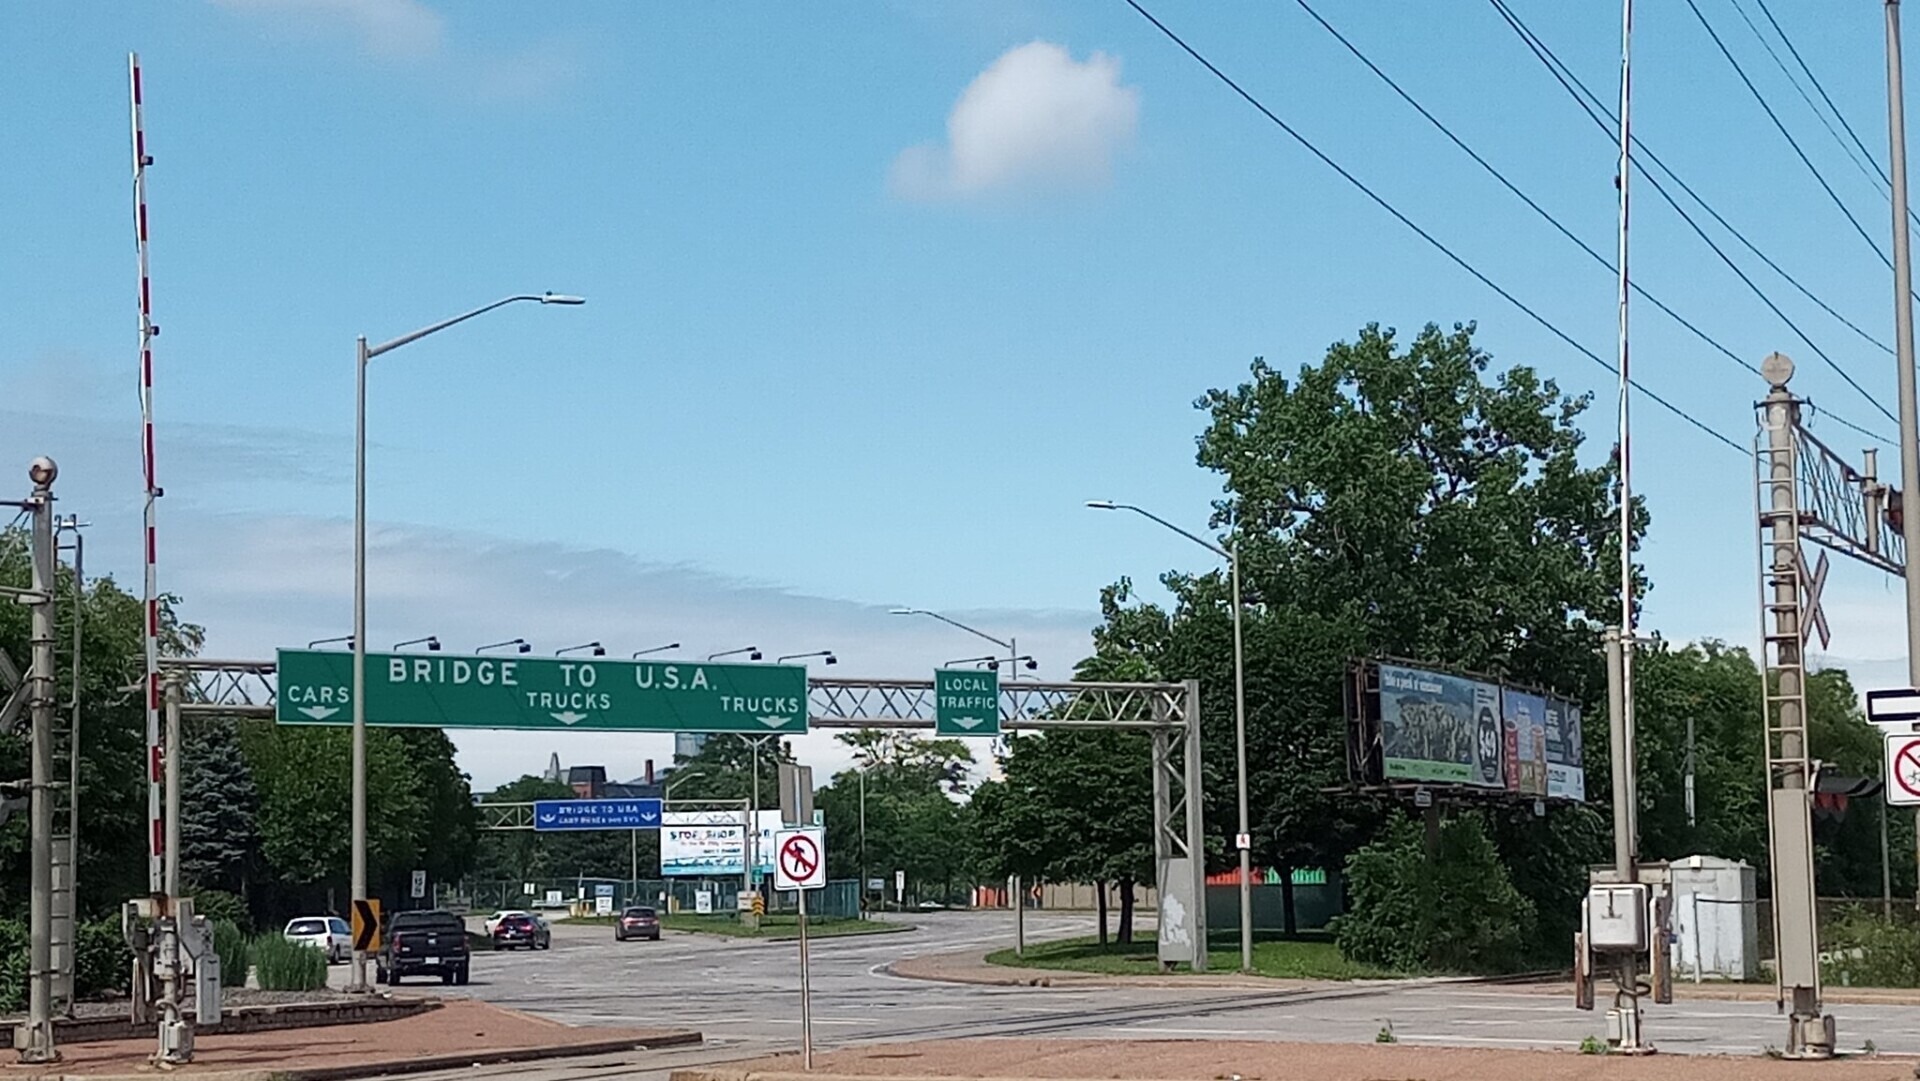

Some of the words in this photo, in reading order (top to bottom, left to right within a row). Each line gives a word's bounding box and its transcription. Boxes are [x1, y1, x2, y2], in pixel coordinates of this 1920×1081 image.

[388, 657, 519, 686] BRIDGE
[559, 663, 597, 687] TO
[635, 665, 718, 690] U.S.A.
[945, 678, 989, 691] LOCAL
[287, 685, 350, 703] CARS
[526, 691, 611, 710] TRUCKS
[940, 696, 996, 709] TRAFFIC
[720, 696, 799, 713] TRUCKS
[558, 805, 598, 815] BRIDGE
[602, 805, 614, 814] TO
